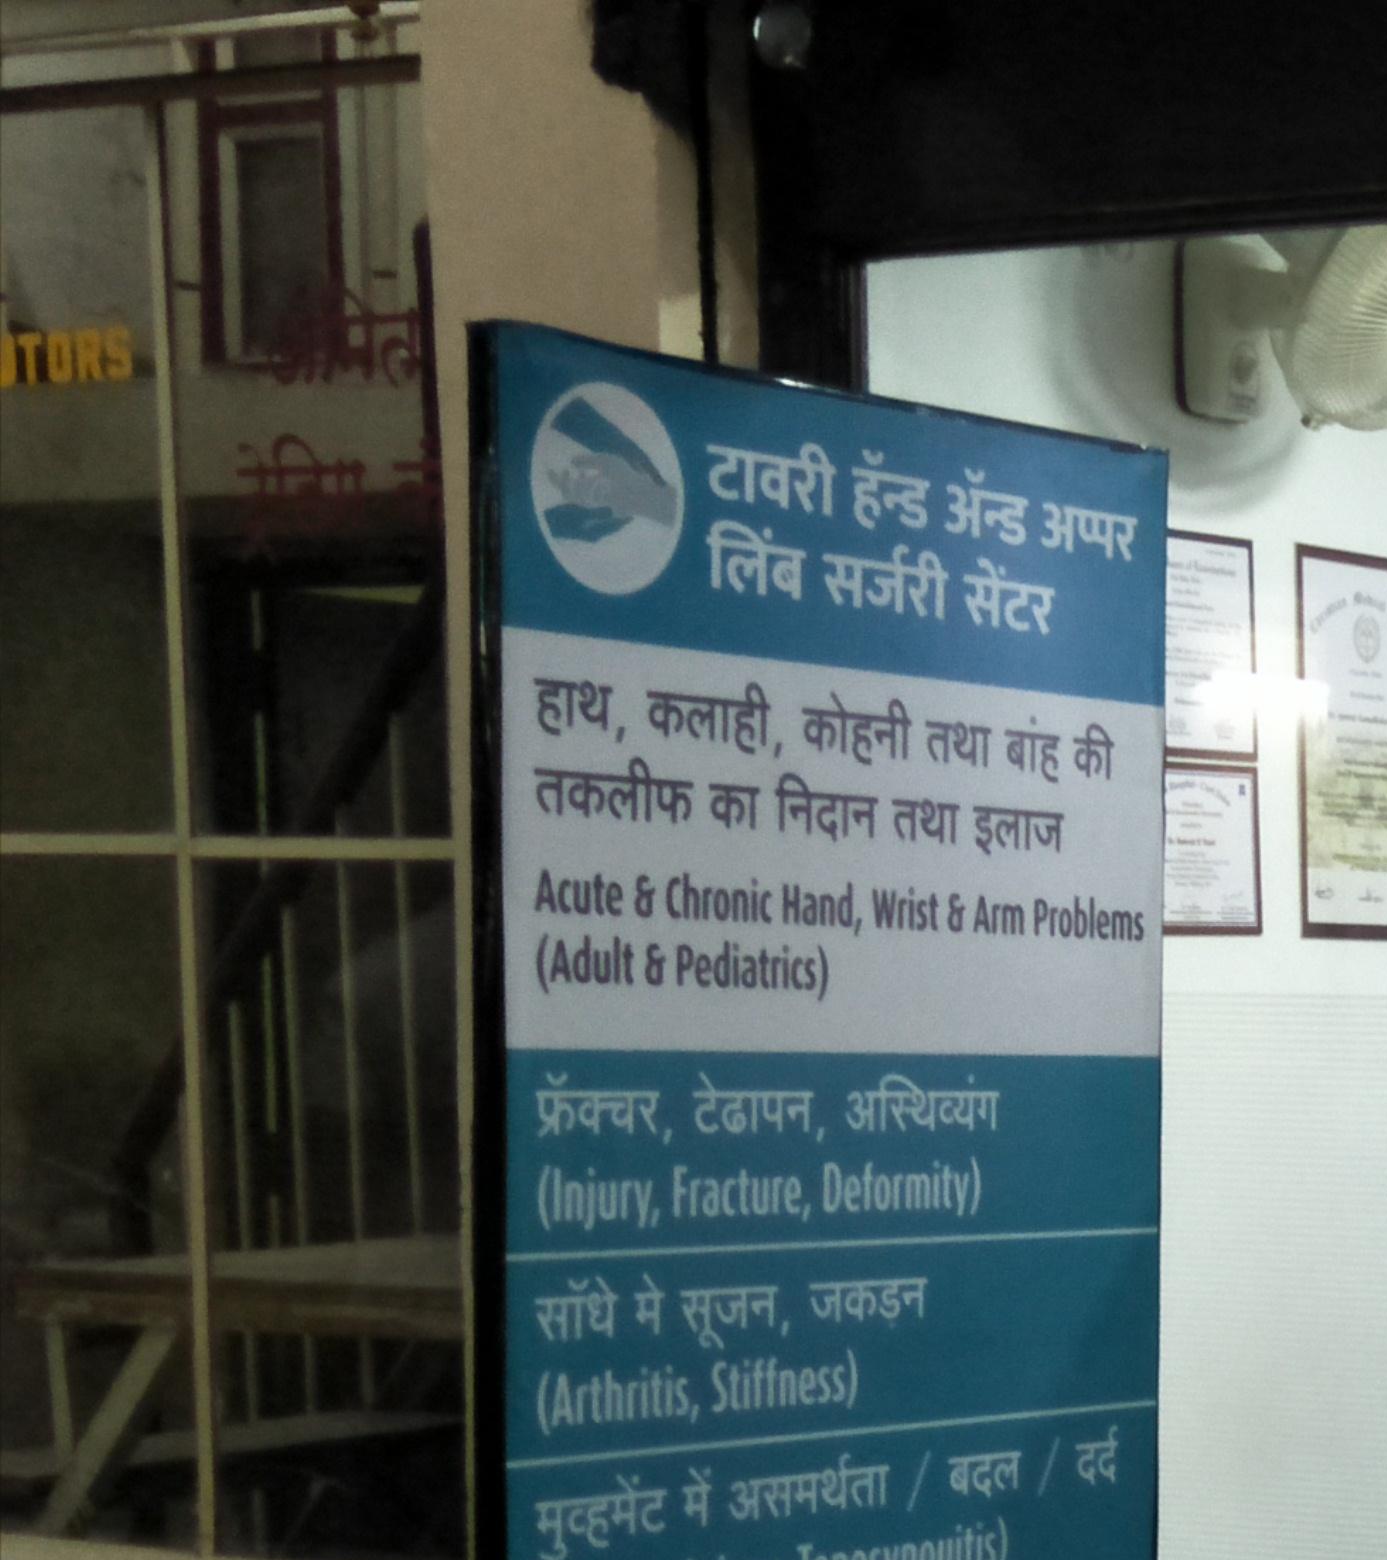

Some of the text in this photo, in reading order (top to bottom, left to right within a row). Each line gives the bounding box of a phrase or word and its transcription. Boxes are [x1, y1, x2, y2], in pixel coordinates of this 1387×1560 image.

[705, 443, 837, 517] टावरी
[852, 449, 931, 530] हॅन्ड
[1041, 501, 1138, 561] अप्पर
[705, 519, 1055, 635] लिंब सर्जरी सेंटर
[533, 677, 1115, 783] हाथ, कलाही, कोहनी तथा बांह की
[534, 757, 1064, 855] तकलीफ का निदान तथा इलाज
[534, 868, 1144, 941] Acute & Chronic Hand, Wrist & Arm Problems
[536, 932, 829, 1001] (Adult & Pediatrics)
[693, 1071, 824, 1143] टेढापन,
[846, 1073, 999, 1134] अस्थिव्यंग
[537, 1156, 982, 1231] (Injury, Fracture, Deformity)
[680, 1285, 790, 1350] सूजन,
[537, 1348, 859, 1436] (Arthritis, Stiffness)
[682, 1465, 712, 1527] में
[729, 1452, 891, 1521] असमर्थता
[907, 1450, 931, 1512] /
[948, 1450, 1022, 1498] बदल
[1037, 1435, 1060, 1497] /
[1075, 1425, 1119, 1485] दर्द
